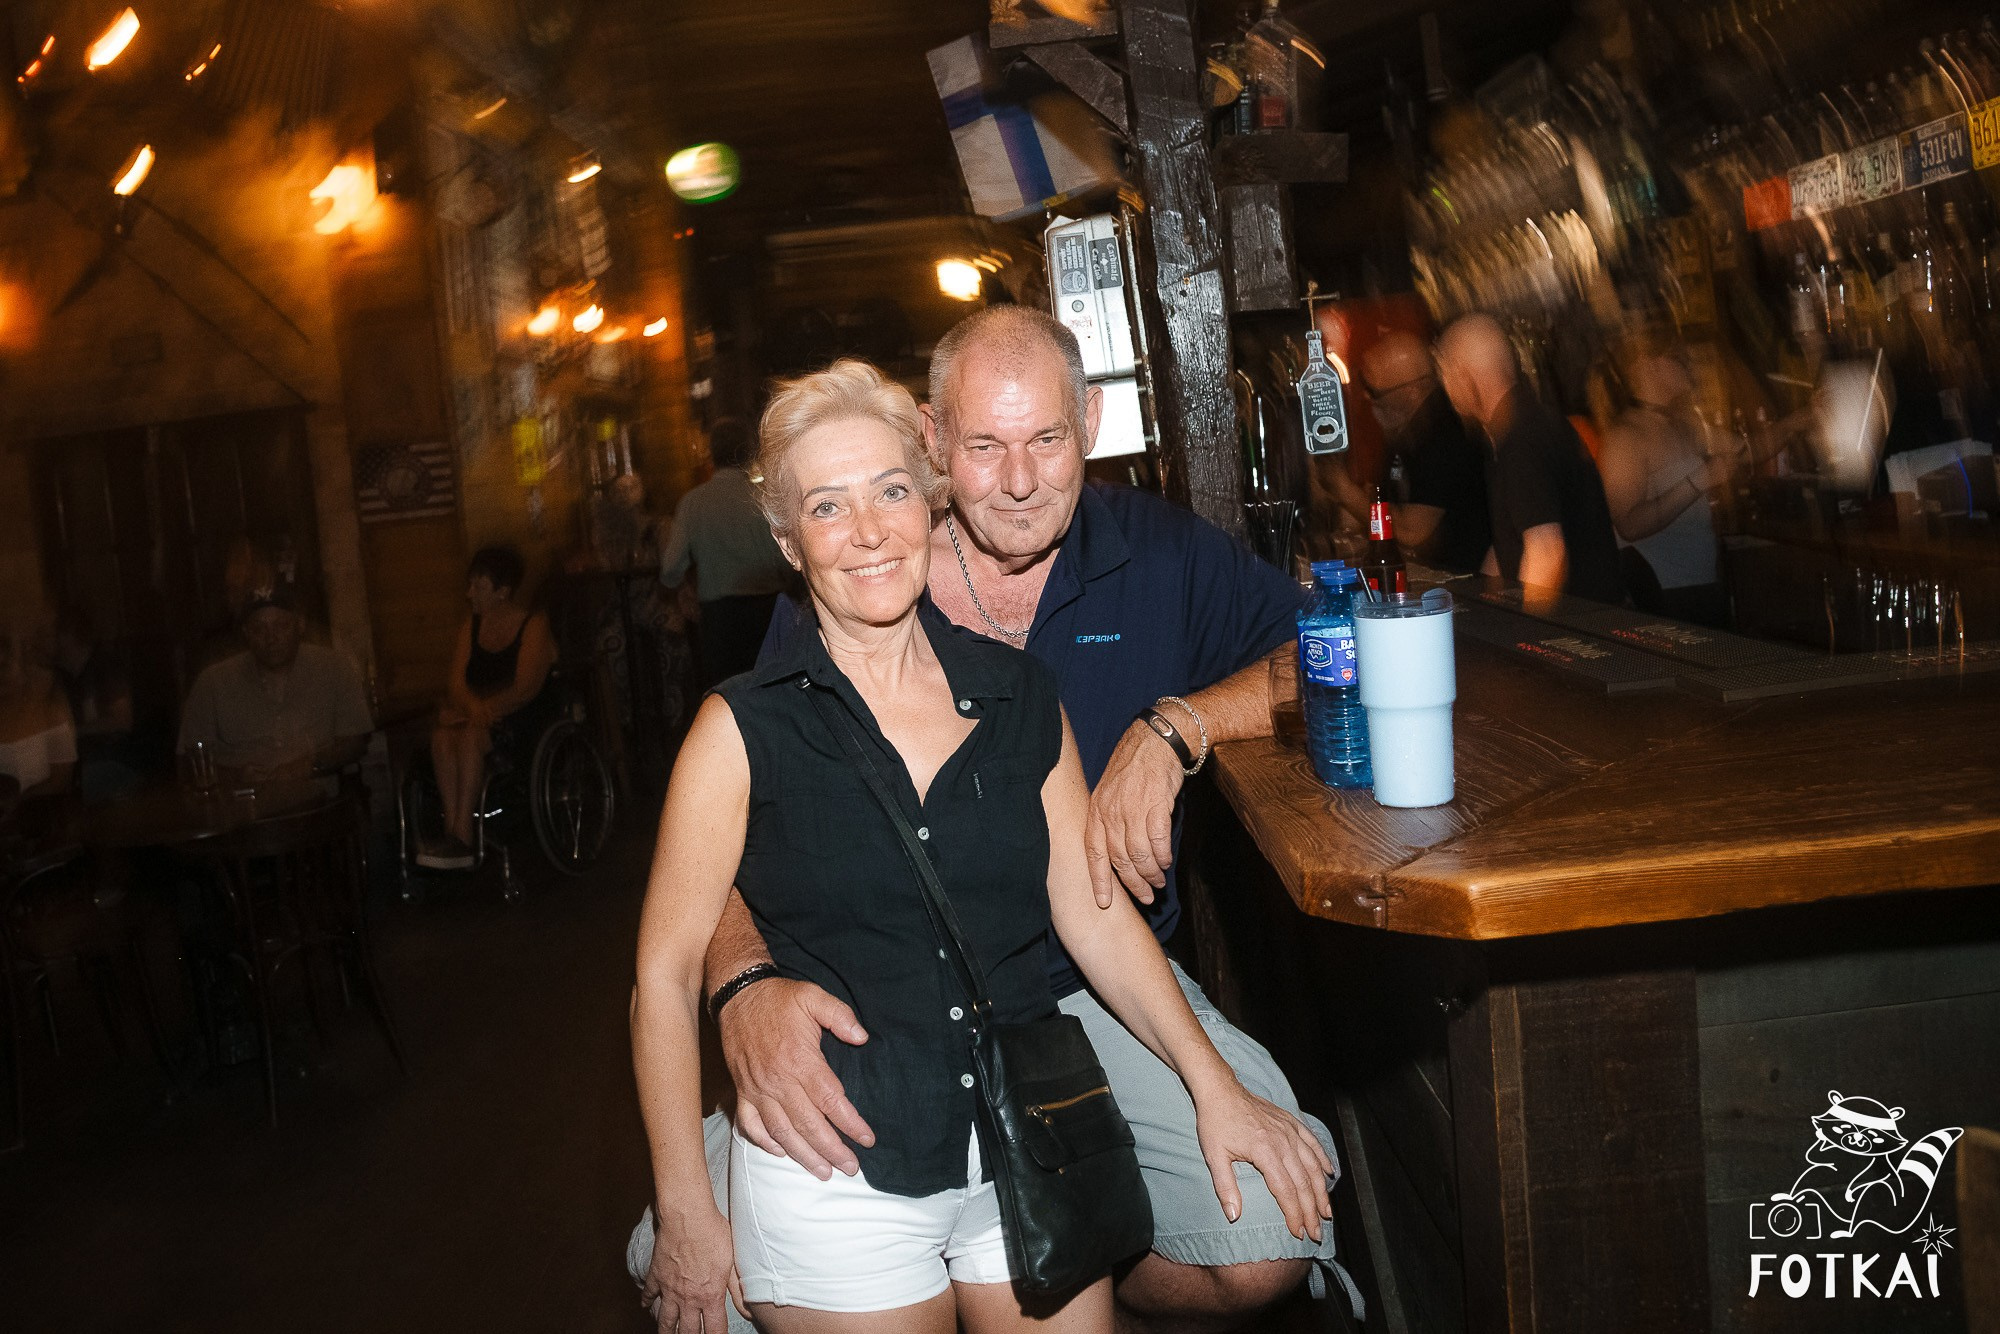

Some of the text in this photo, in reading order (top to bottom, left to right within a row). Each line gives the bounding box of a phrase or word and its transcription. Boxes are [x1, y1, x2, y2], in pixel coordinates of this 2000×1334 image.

[1919, 129, 1964, 168] 531FCV
[1106, 243, 1119, 282] Cardinals
[1307, 381, 1331, 390] BEER
[1341, 639, 1355, 650] BA
